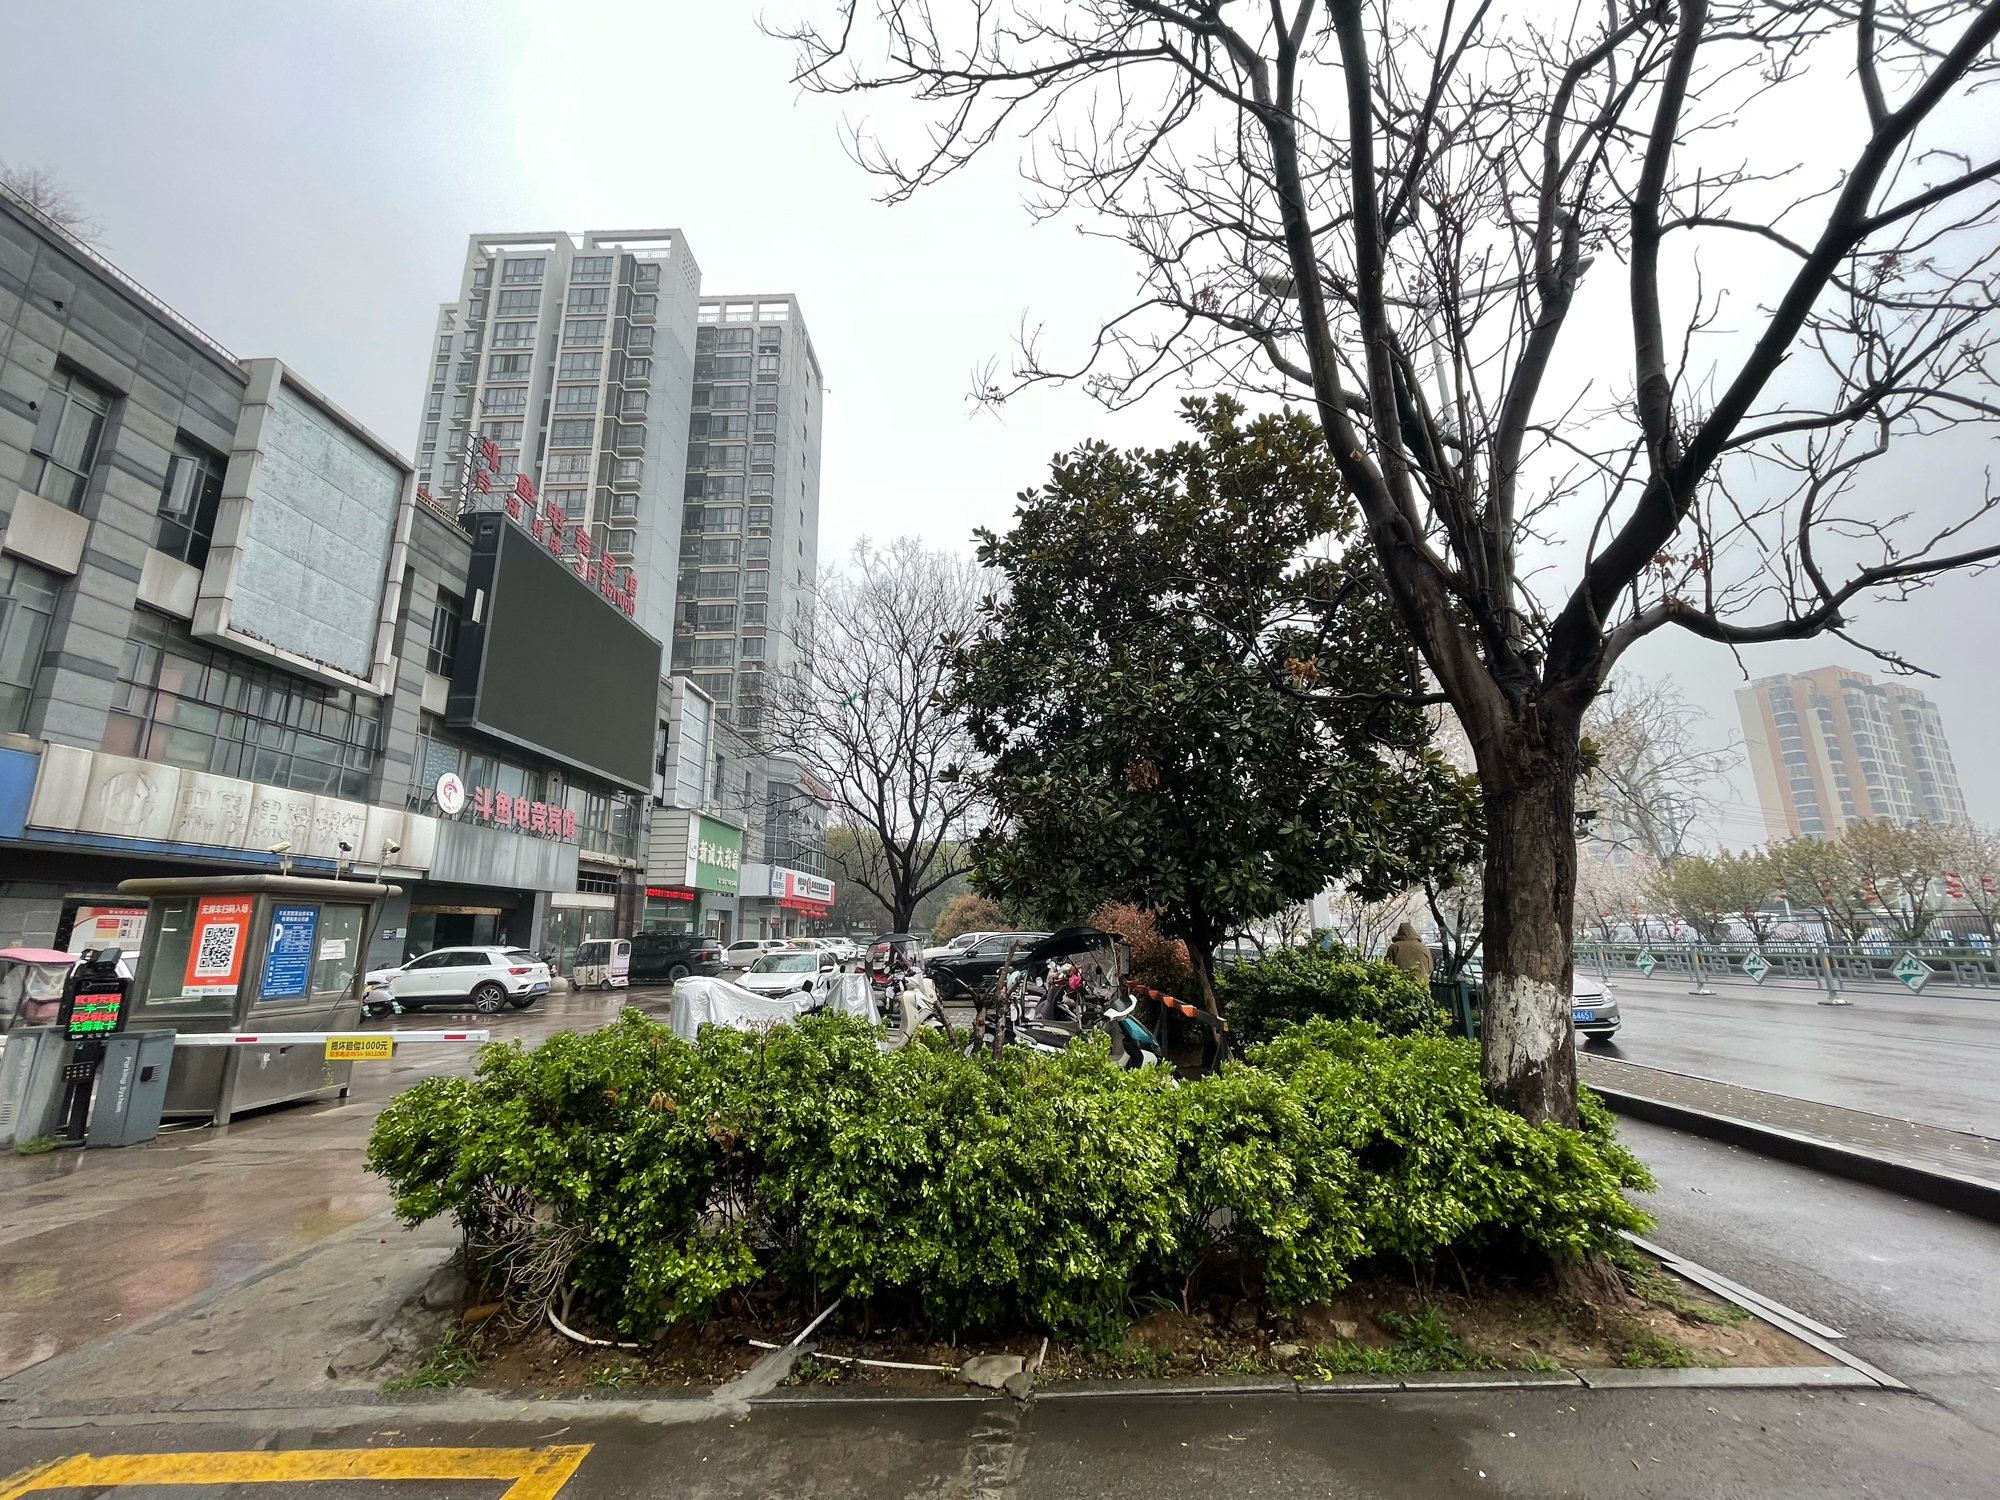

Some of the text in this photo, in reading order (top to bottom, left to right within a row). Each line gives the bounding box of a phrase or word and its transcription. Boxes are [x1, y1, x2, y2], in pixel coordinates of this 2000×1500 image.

[478, 436, 638, 597] 斗鱼电竞宾馆
[474, 785, 576, 838] 斗鱼电竞宾馆
[201, 903, 249, 915] 无牌车扫码入场
[271, 923, 284, 953] P
[68, 1020, 117, 1032] 无需取卡
[331, 1041, 388, 1051] 损坏赔偿1000元
[115, 1056, 132, 1113] Parking System
